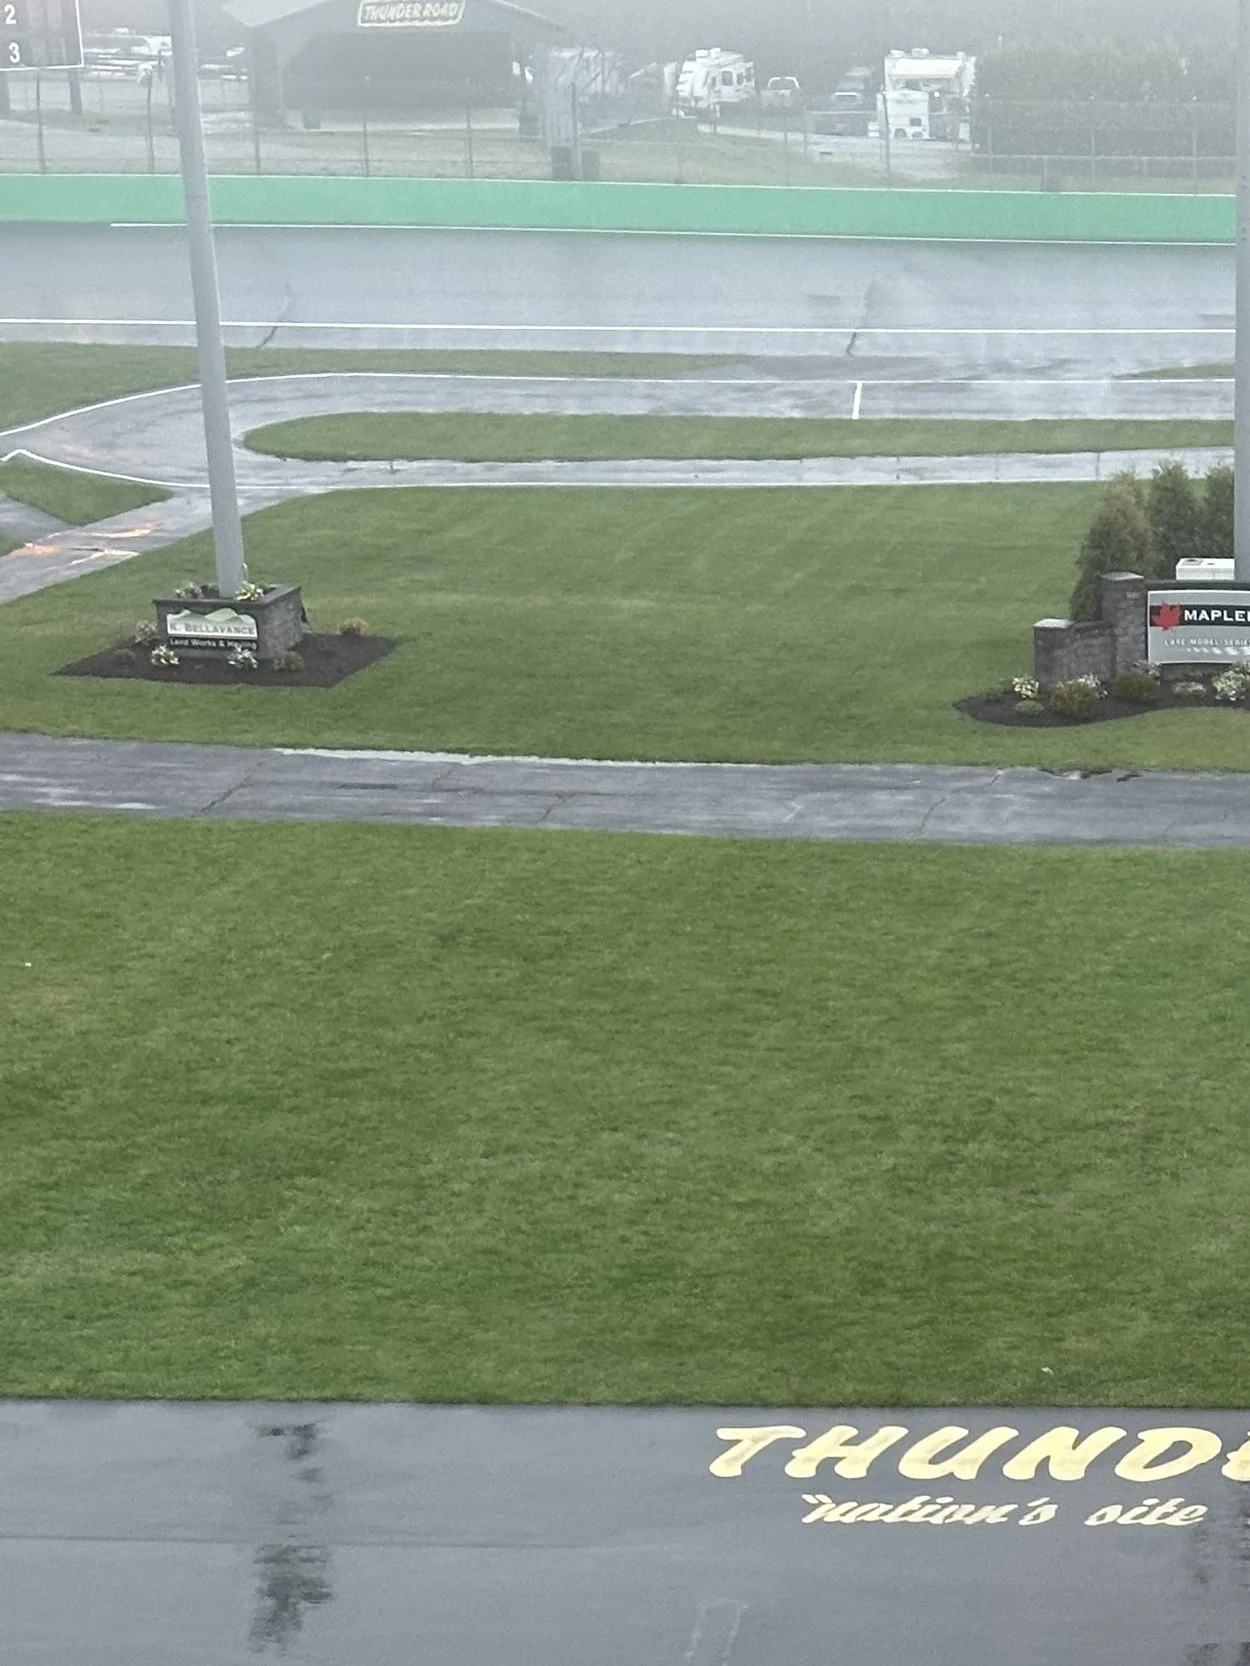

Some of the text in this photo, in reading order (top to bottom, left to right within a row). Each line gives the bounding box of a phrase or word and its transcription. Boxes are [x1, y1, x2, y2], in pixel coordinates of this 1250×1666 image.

[4, 3, 17, 25] 2
[364, 2, 459, 20] THUNDER ROAD
[8, 42, 21, 64] 3
[1084, 1497, 1209, 1527] site
